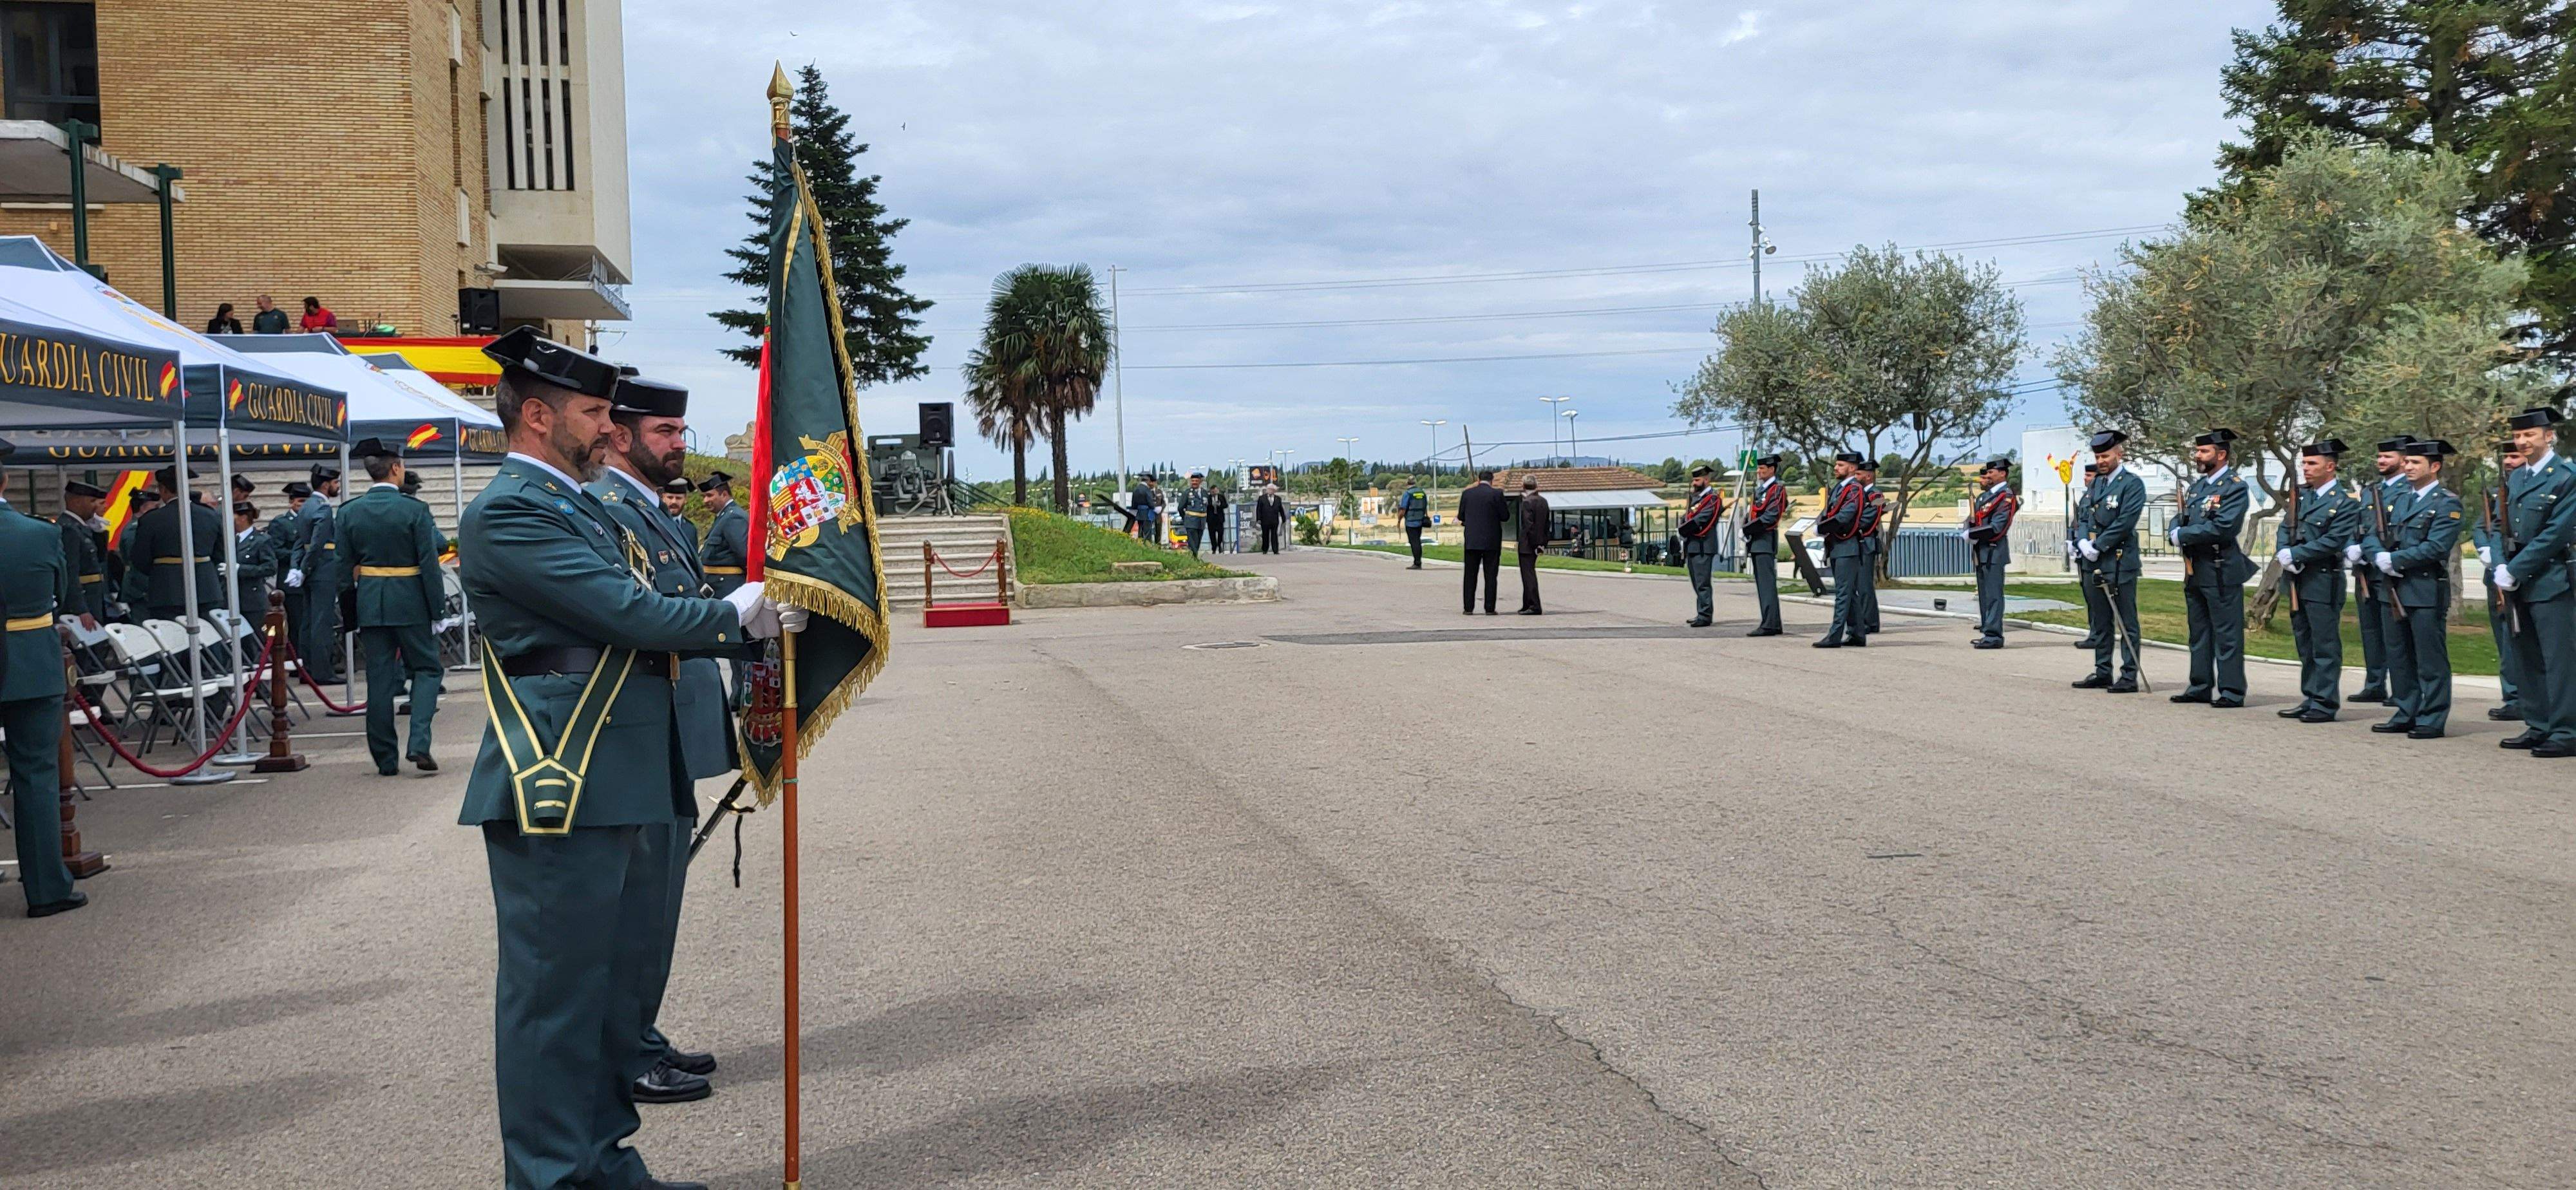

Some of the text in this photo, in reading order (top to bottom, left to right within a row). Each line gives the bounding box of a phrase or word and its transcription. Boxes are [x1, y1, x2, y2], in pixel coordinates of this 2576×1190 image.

[99, 351, 154, 401] CIVIL
[248, 382, 334, 430] GUARDIA CIVIL
